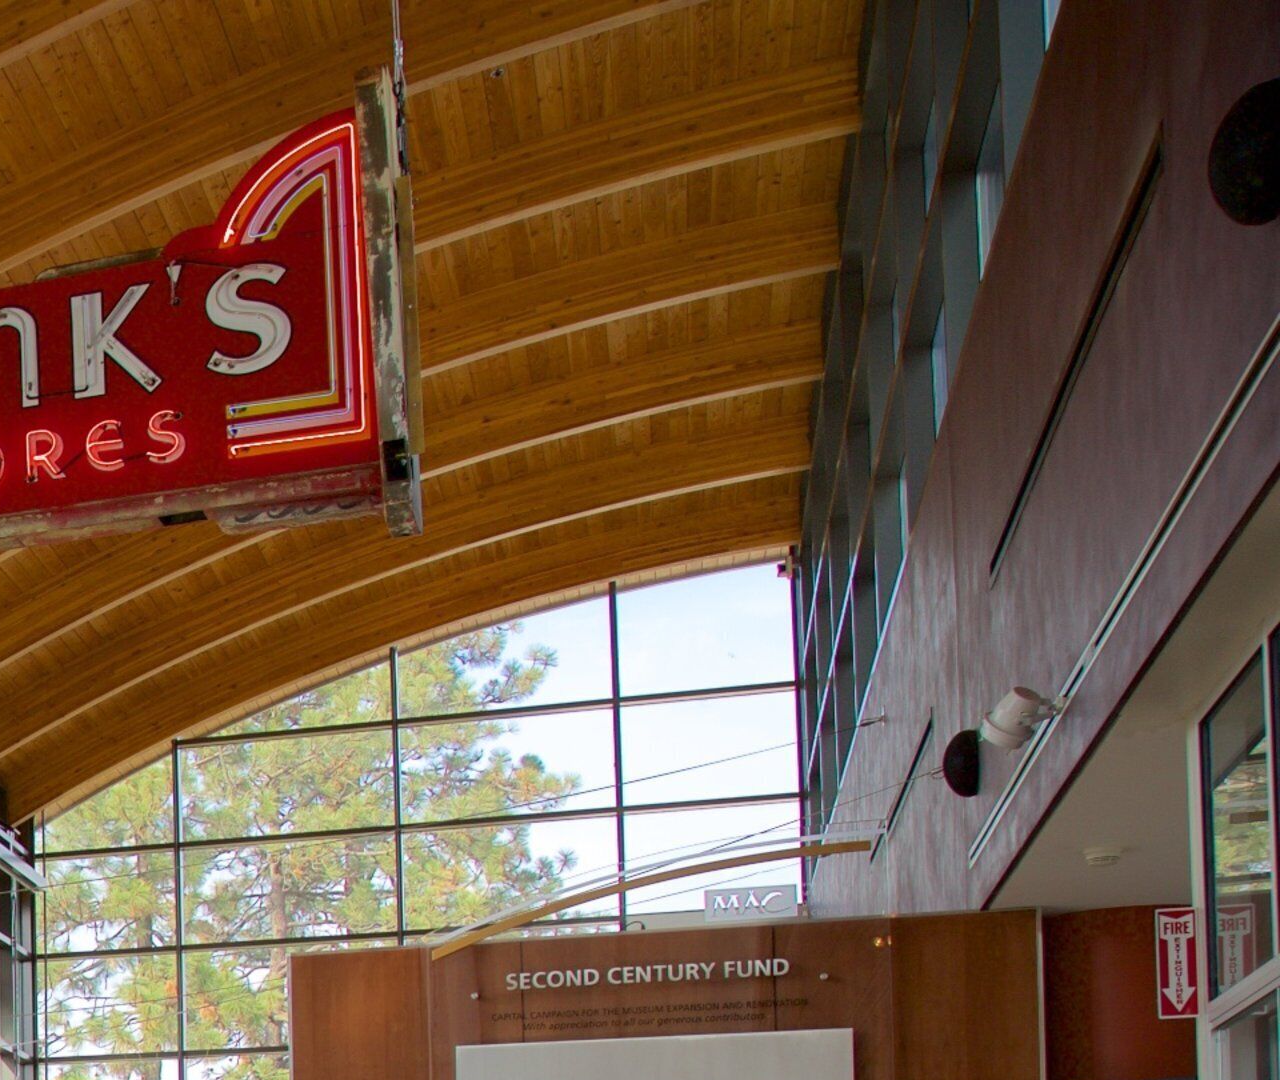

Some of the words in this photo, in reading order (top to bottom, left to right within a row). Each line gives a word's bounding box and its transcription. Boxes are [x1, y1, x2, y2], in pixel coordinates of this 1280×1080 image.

[1163, 920, 1191, 936] FIRE
[506, 968, 600, 991] SECOND
[607, 962, 716, 985] CENTURY
[724, 957, 790, 979] FUND
[491, 1011, 526, 1023] CAPITAL
[529, 1009, 580, 1020] CAMPAIGN
[581, 1008, 600, 1018] FOR
[603, 1007, 621, 1016] THE
[622, 1005, 664, 1016] MUSEUM
[666, 1002, 720, 1013] EXPANSION
[722, 1001, 744, 1010] AND
[522, 1022, 547, 1032] With
[549, 1020, 609, 1032] appreciation
[611, 1019, 622, 1028] to
[623, 1018, 636, 1027] all
[637, 1018, 655, 1026] our
[657, 1014, 703, 1028] generous
